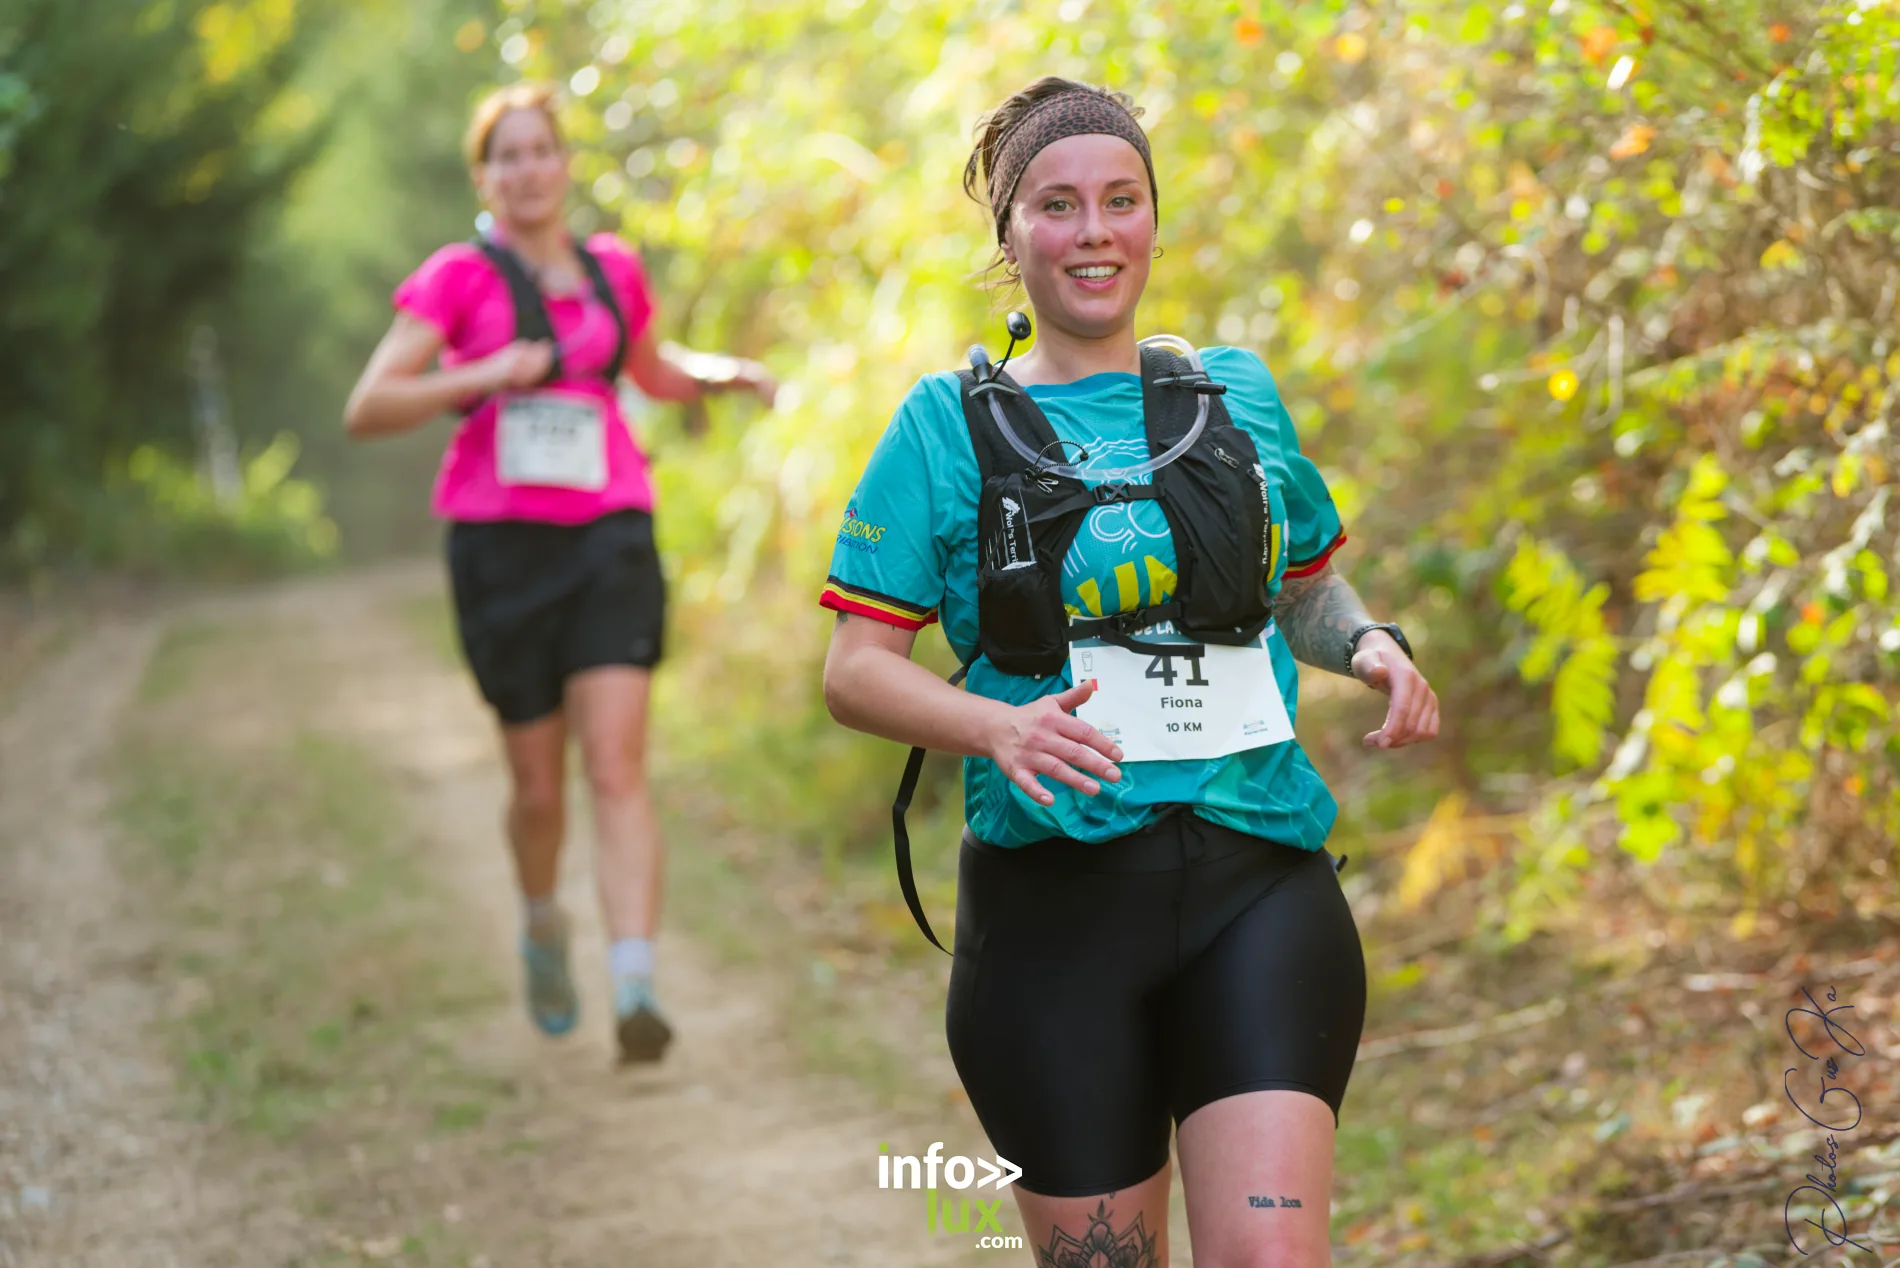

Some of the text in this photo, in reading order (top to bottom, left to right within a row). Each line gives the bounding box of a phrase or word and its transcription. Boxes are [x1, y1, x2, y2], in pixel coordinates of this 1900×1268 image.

[1009, 539, 1019, 563] Terri
[1156, 619, 1175, 635] LA
[1145, 654, 1209, 686] 41
[1160, 696, 1203, 709] Fiona
[1165, 722, 1202, 732] 10 KM
